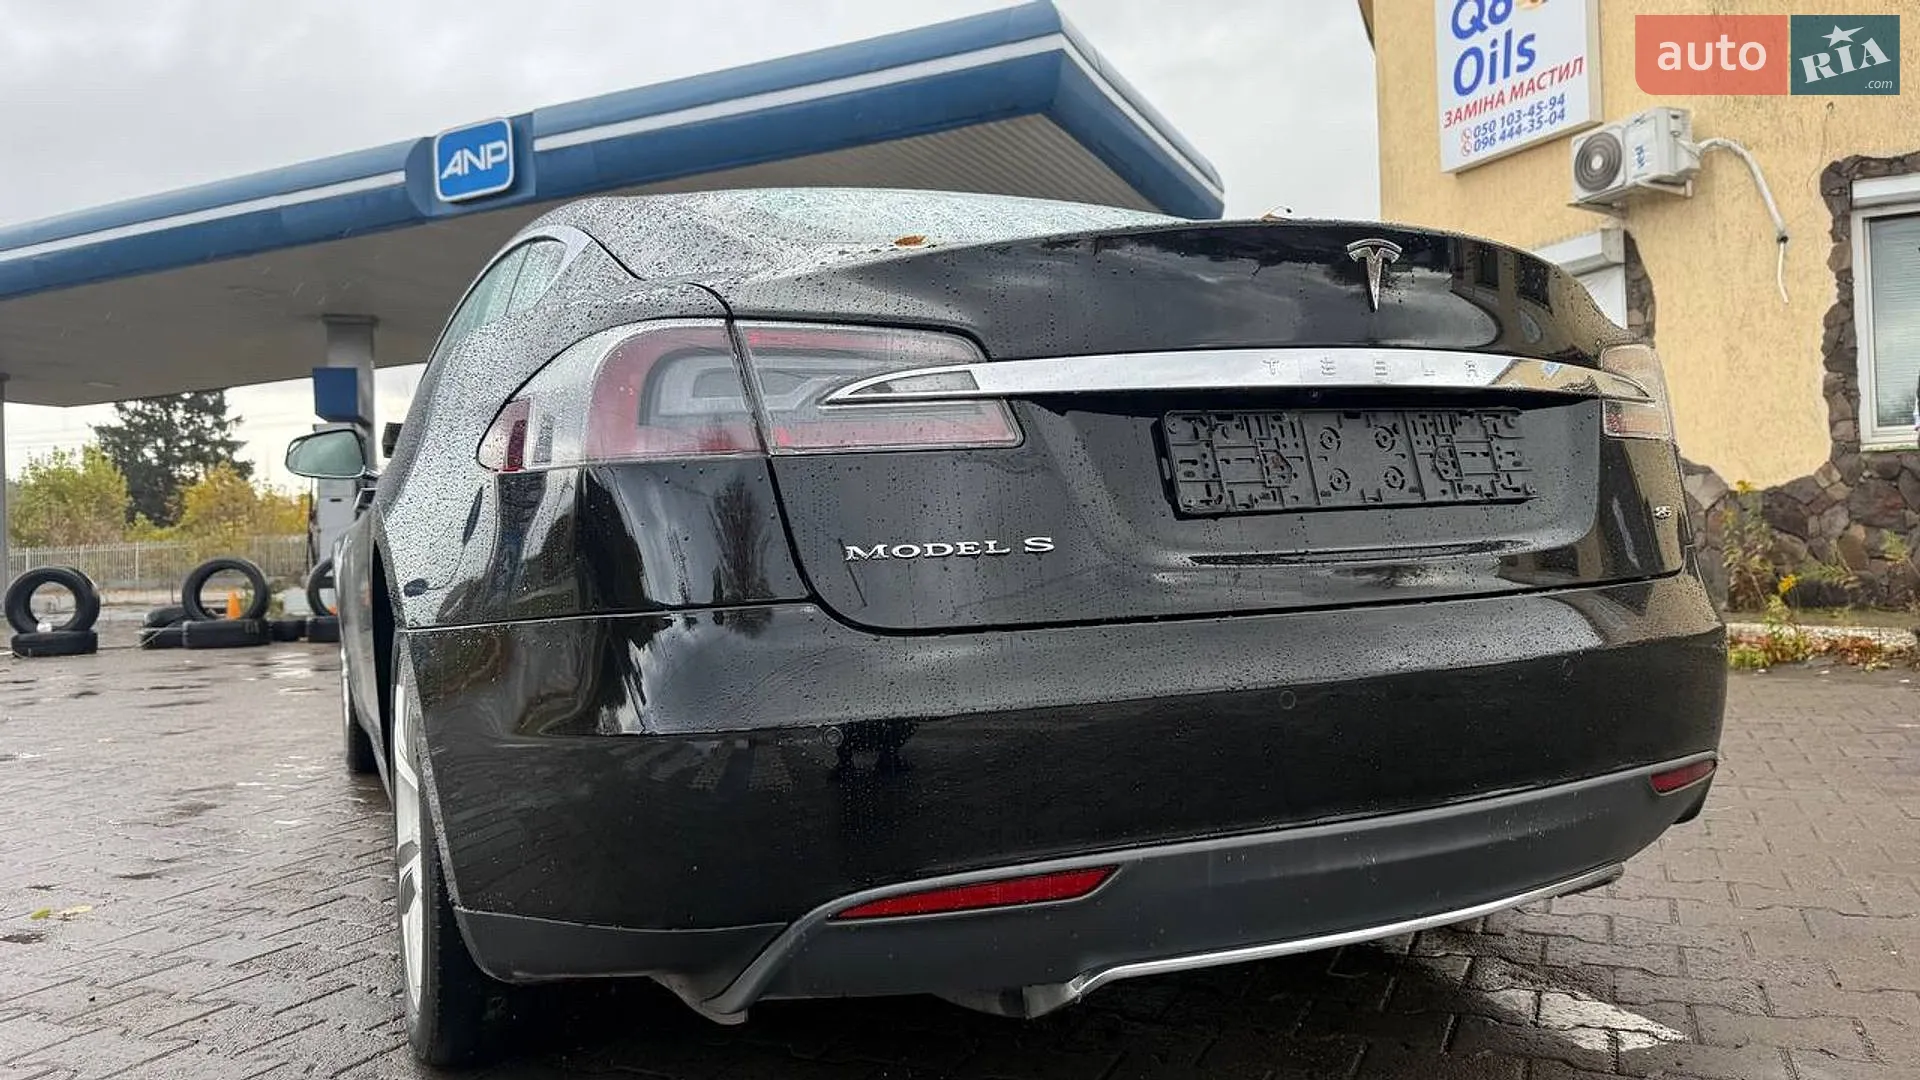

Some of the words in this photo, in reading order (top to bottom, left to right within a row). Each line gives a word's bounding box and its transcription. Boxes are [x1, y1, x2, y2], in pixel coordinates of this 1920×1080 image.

[1454, 29, 1536, 96] Oils
[1443, 91, 1505, 129] ЗАМІНА
[1509, 56, 1584, 102] МАСТИЛ
[1473, 120, 1497, 139] 050
[1500, 92, 1566, 128] 103-45-94
[1473, 132, 1497, 153] 096
[1499, 107, 1566, 143] 444-35-04
[440, 140, 508, 180] ANP
[844, 540, 1011, 561] MODEL
[1023, 536, 1055, 553] S
